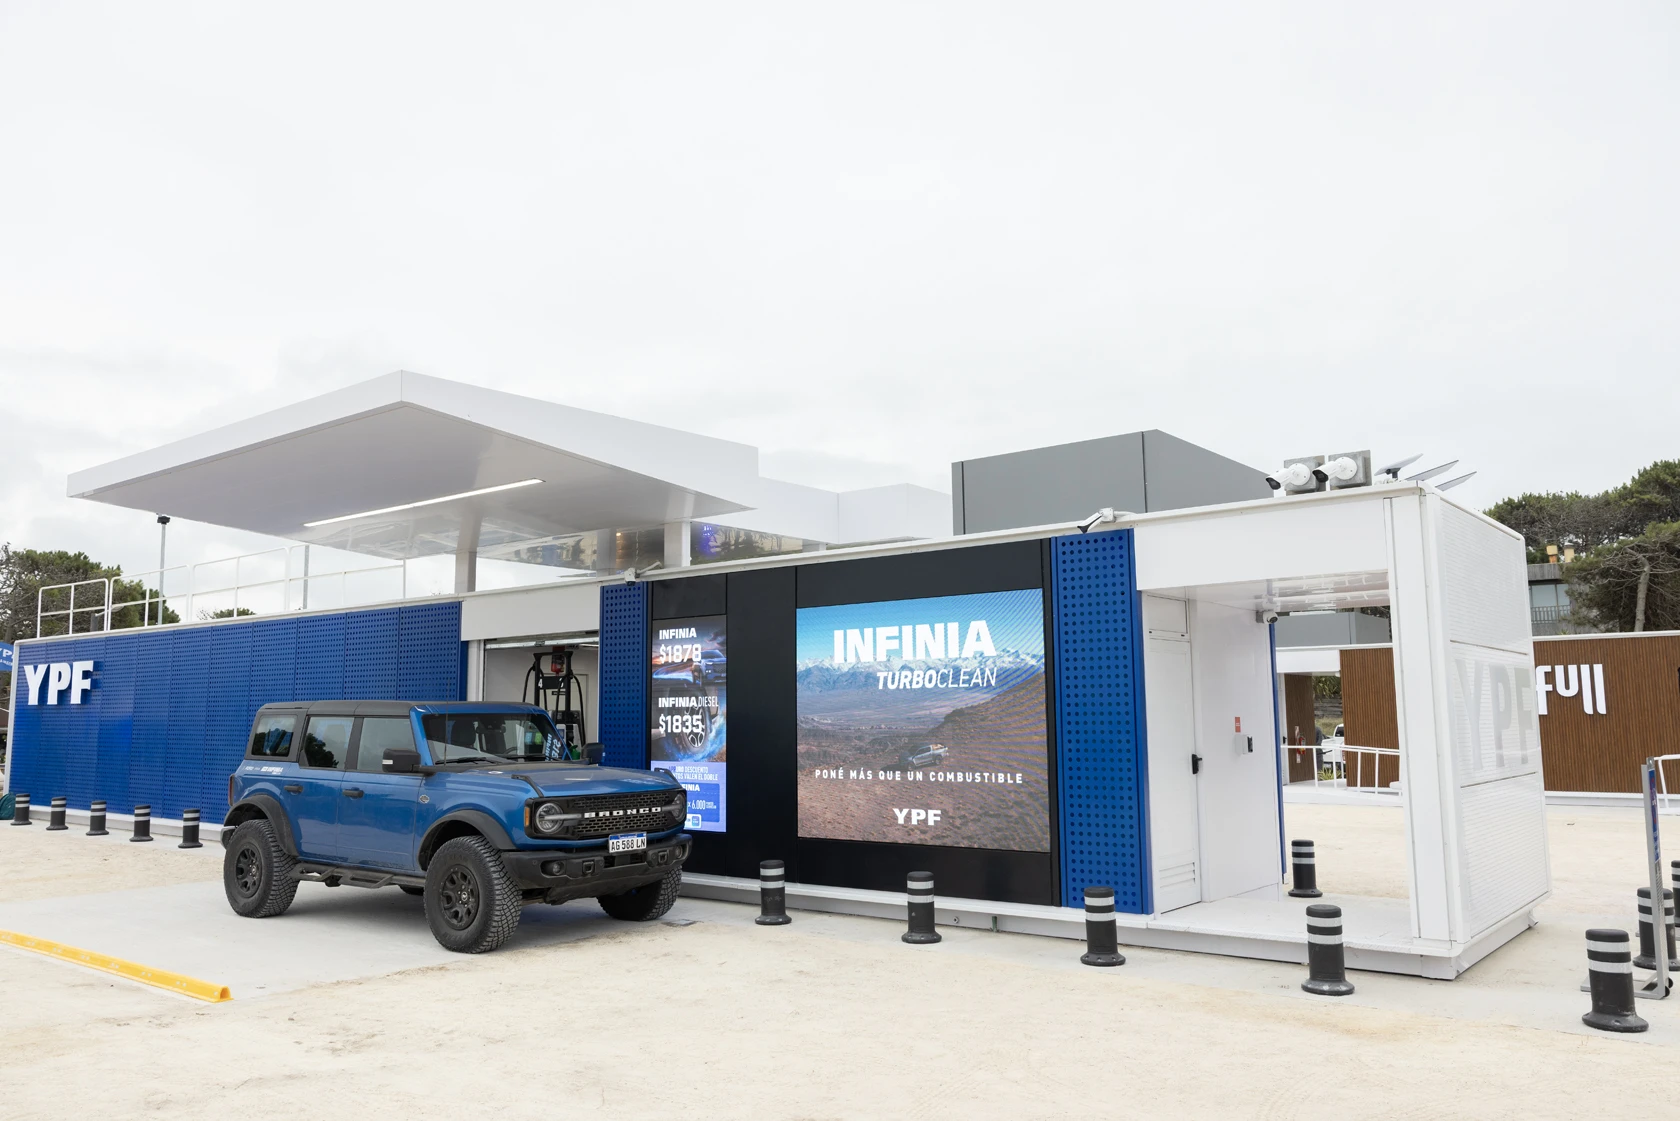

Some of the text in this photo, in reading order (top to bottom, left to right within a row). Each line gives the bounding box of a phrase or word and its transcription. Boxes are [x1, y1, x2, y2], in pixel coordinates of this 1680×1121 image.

[659, 628, 697, 639] INFINIA
[834, 620, 997, 663] INFINIA
[659, 644, 701, 663] $1878
[24, 660, 94, 705] YPF
[877, 668, 997, 690] TURBOCLEAN
[1535, 663, 1606, 715] full
[658, 696, 697, 707] INFINIA
[1455, 658, 1534, 770] YPF
[659, 714, 702, 733] $1835
[815, 767, 1023, 784] PONÉ MÁS QUE UN COMBUSTIBLE
[584, 806, 661, 819] BRONCO
[692, 800, 705, 810] 6.000
[892, 808, 941, 826] YPF
[611, 840, 620, 851] AG
[636, 838, 645, 848] LN
